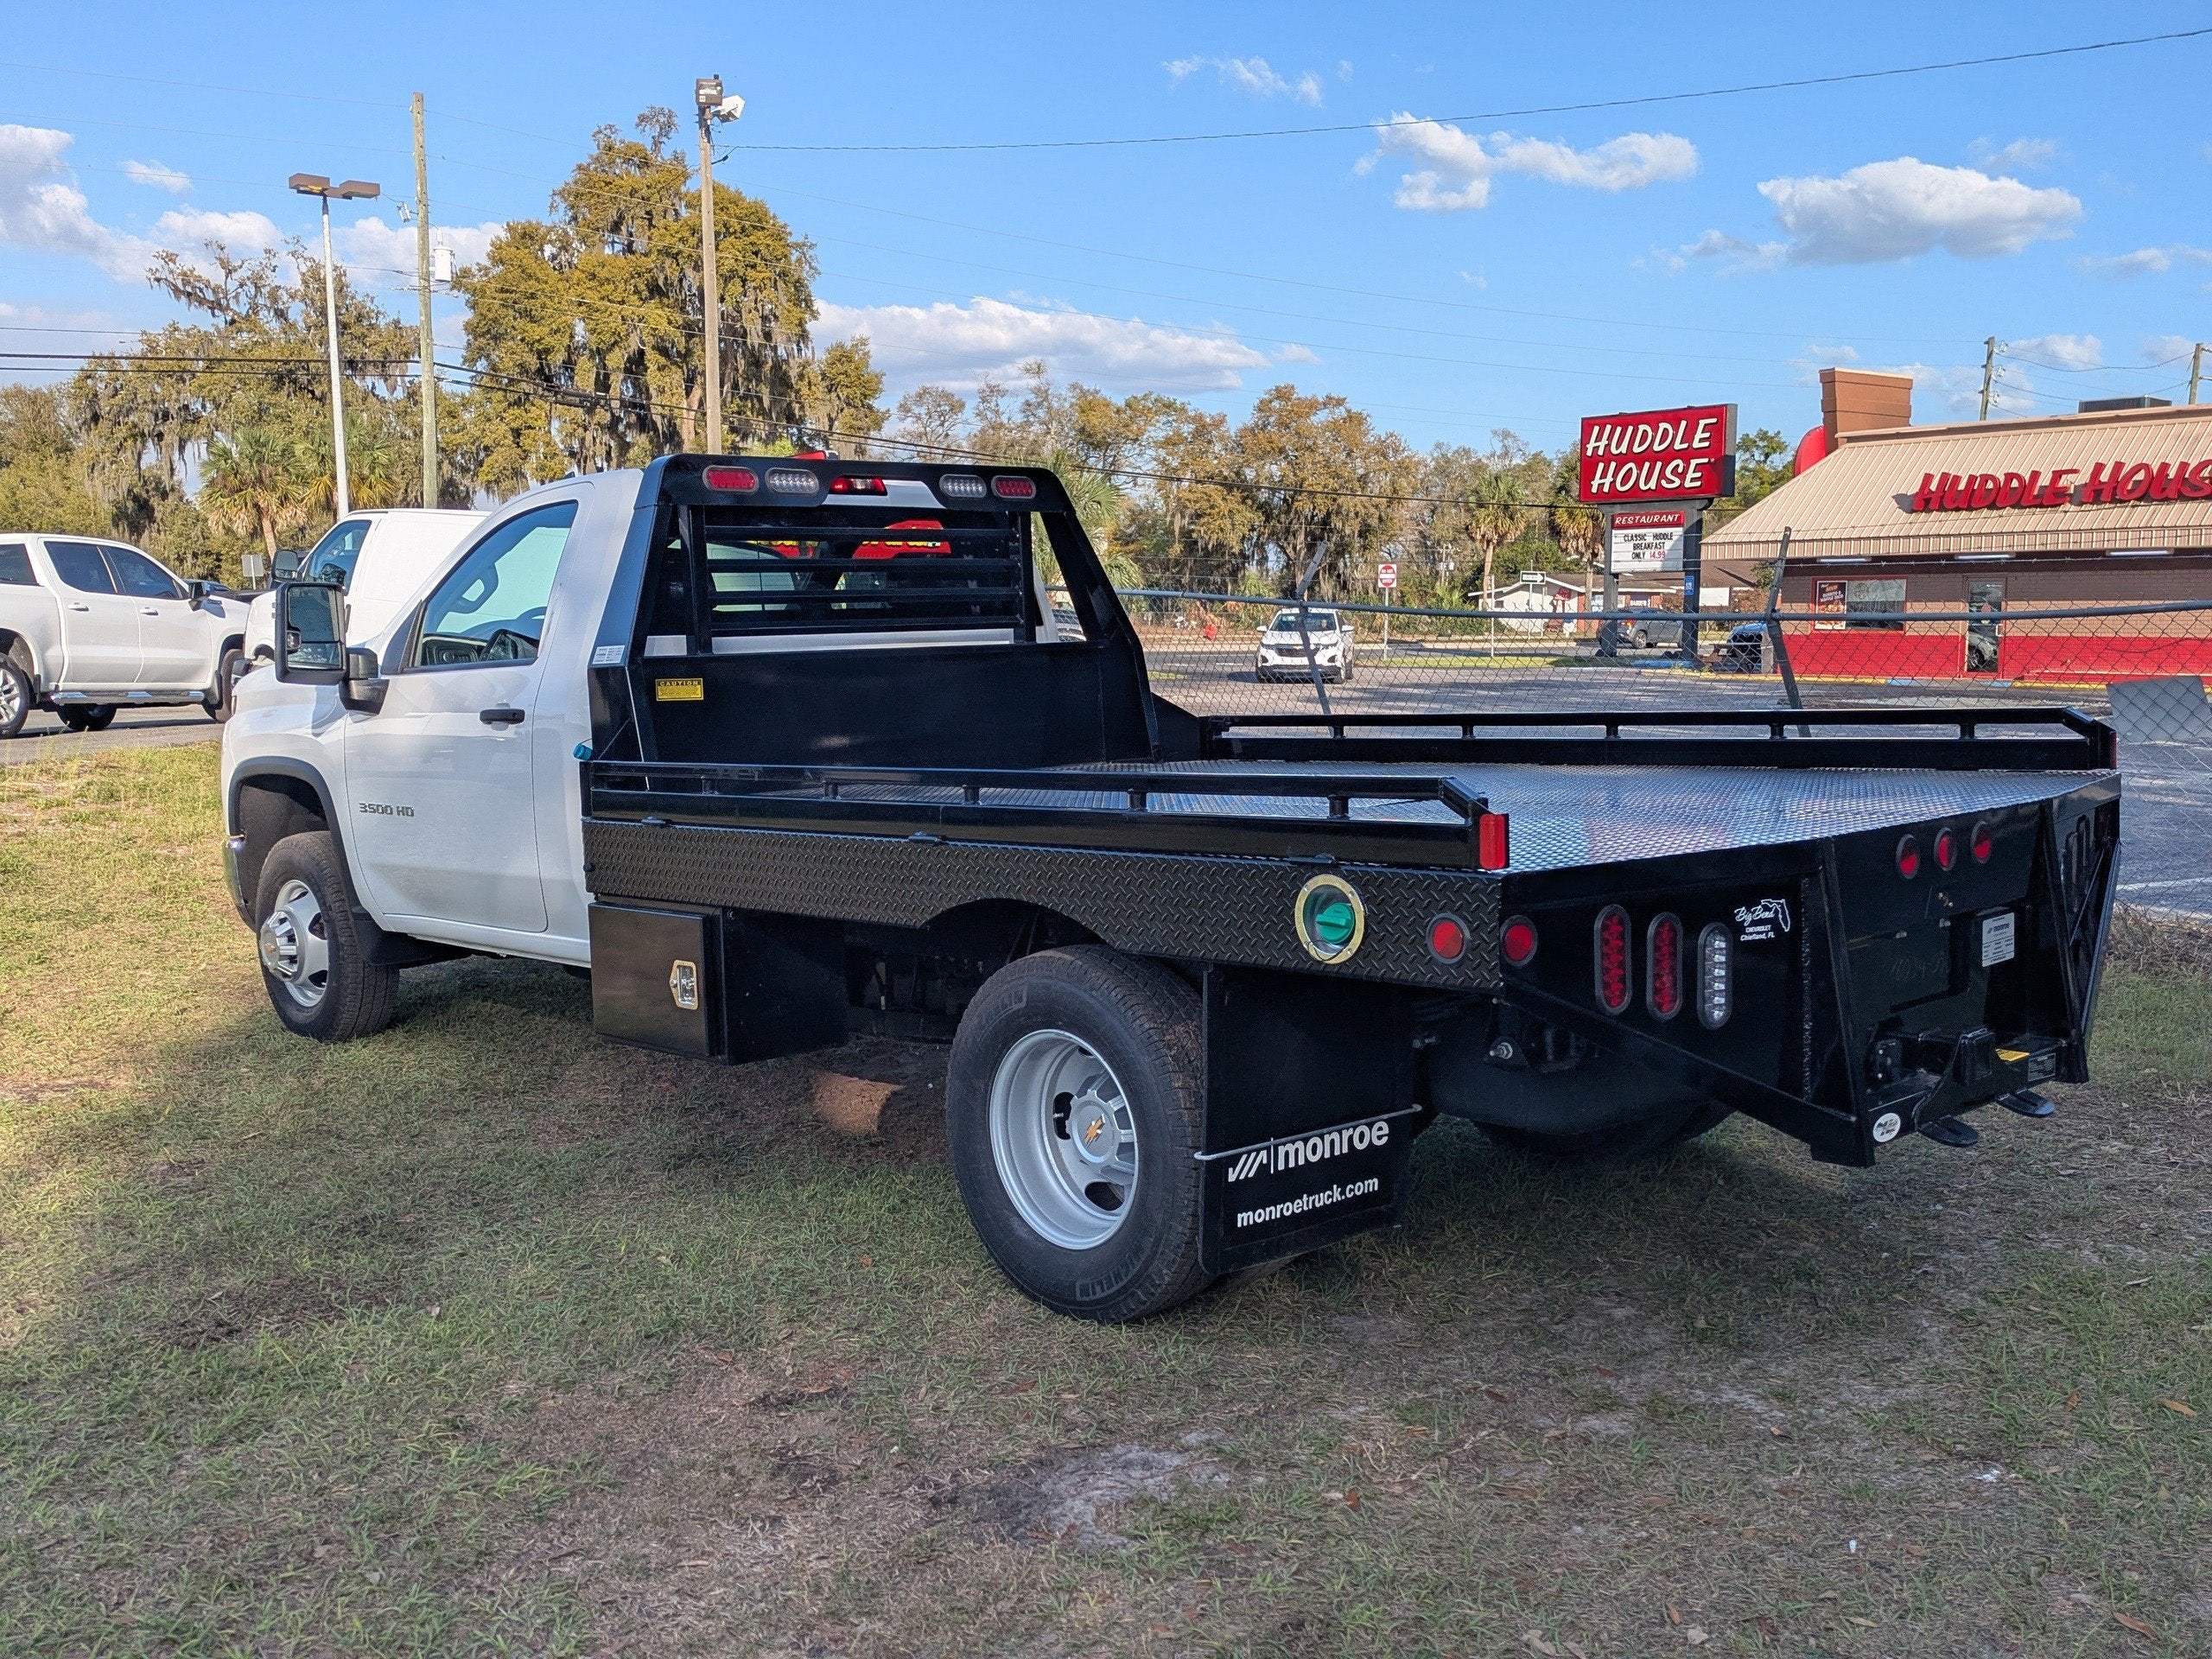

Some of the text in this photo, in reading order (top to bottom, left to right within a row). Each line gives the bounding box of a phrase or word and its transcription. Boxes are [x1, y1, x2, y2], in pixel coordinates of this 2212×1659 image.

[1586, 418, 1718, 457] HUDDLE
[1591, 458, 1709, 494] HOUSE
[1912, 469, 2080, 511] HUDDLE
[1615, 514, 1679, 525] RESTAURANT
[1624, 532, 1674, 542] CLASSIC HUDDLE
[1632, 542, 1666, 550] BREAKFAST
[1631, 551, 1646, 560] ONLY
[359, 803, 415, 817] 3500 HD
[1734, 906, 1752, 926] Big
[1277, 1121, 1389, 1171] monroe
[1236, 1178, 1379, 1228] monroetruck.com
